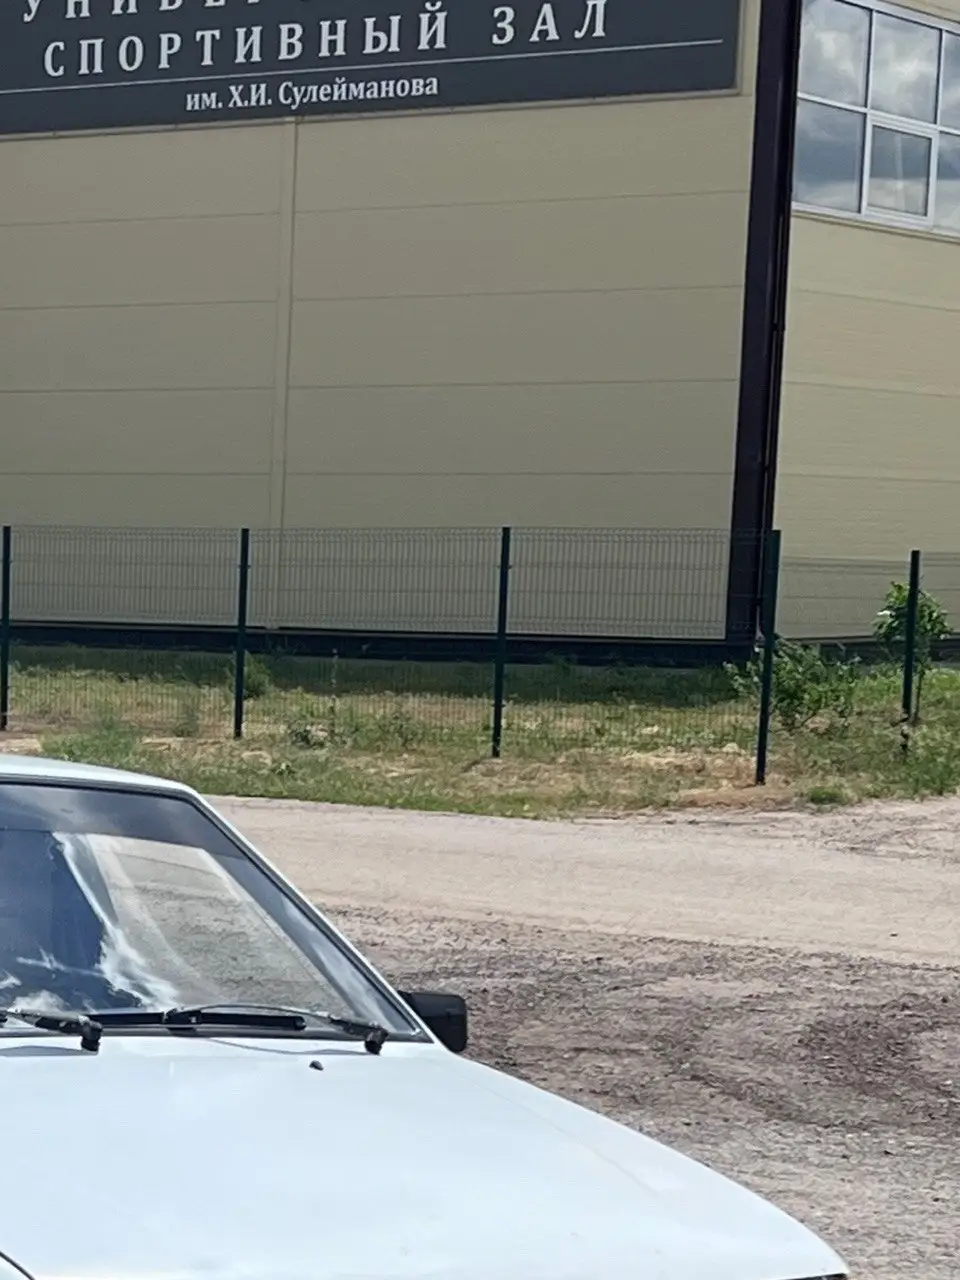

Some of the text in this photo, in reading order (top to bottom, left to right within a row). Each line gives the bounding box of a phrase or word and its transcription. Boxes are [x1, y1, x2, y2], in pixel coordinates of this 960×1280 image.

[43, 0, 609, 77] СПОРТИВНЫЙ ЗАЛ
[185, 76, 439, 111] им. Х.И. Сулейманова
